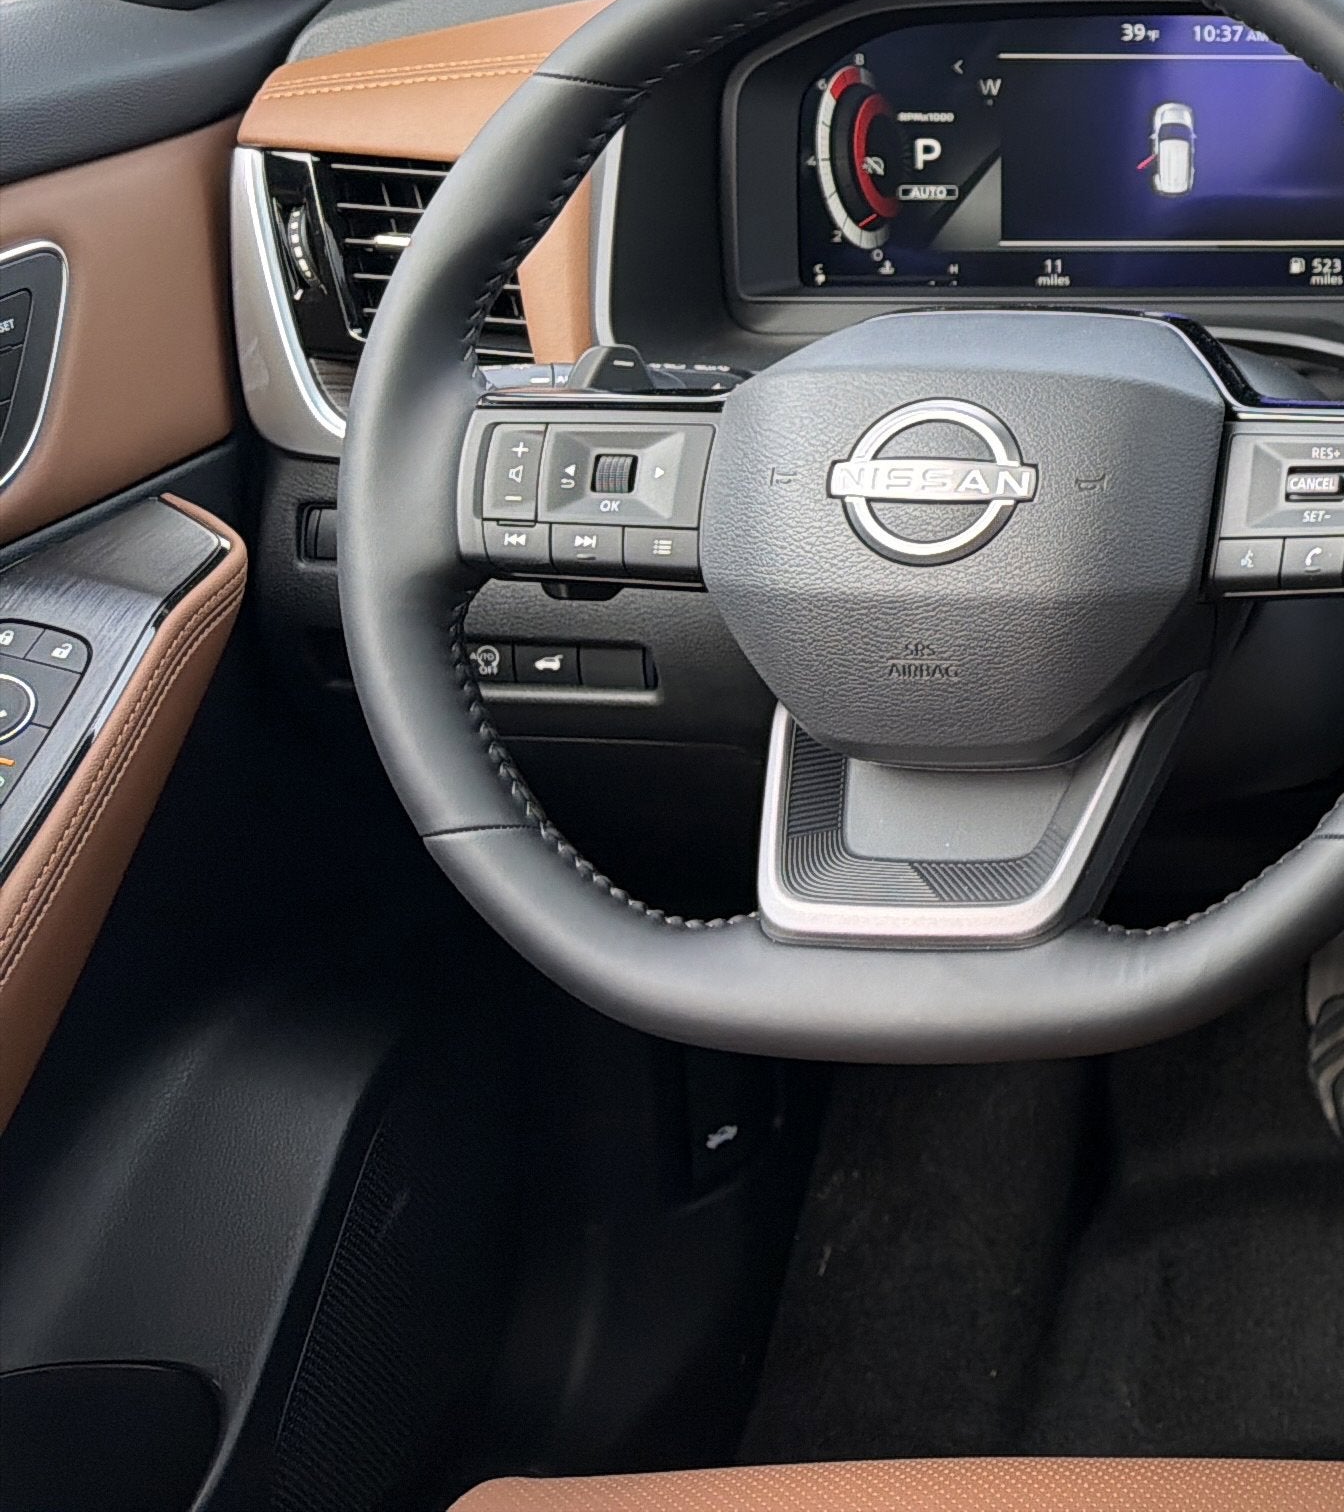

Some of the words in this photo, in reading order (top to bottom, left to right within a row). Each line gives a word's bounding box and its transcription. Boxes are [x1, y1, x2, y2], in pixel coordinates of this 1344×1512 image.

[1193, 24, 1244, 43] 10:37
[979, 79, 1002, 96] W
[914, 138, 942, 170] P
[910, 186, 947, 199] AUTO
[832, 230, 843, 243] 2
[872, 249, 884, 262] 0
[1043, 258, 1063, 273] 11
[1311, 258, 1342, 274] 523
[1036, 274, 1070, 287] miles
[1309, 274, 1344, 287] miles
[839, 467, 1031, 496] NISSAN
[1289, 477, 1336, 490] CANCEL
[600, 500, 620, 512] OK
[904, 642, 937, 657] SRS
[887, 662, 961, 678] AIRBAG
